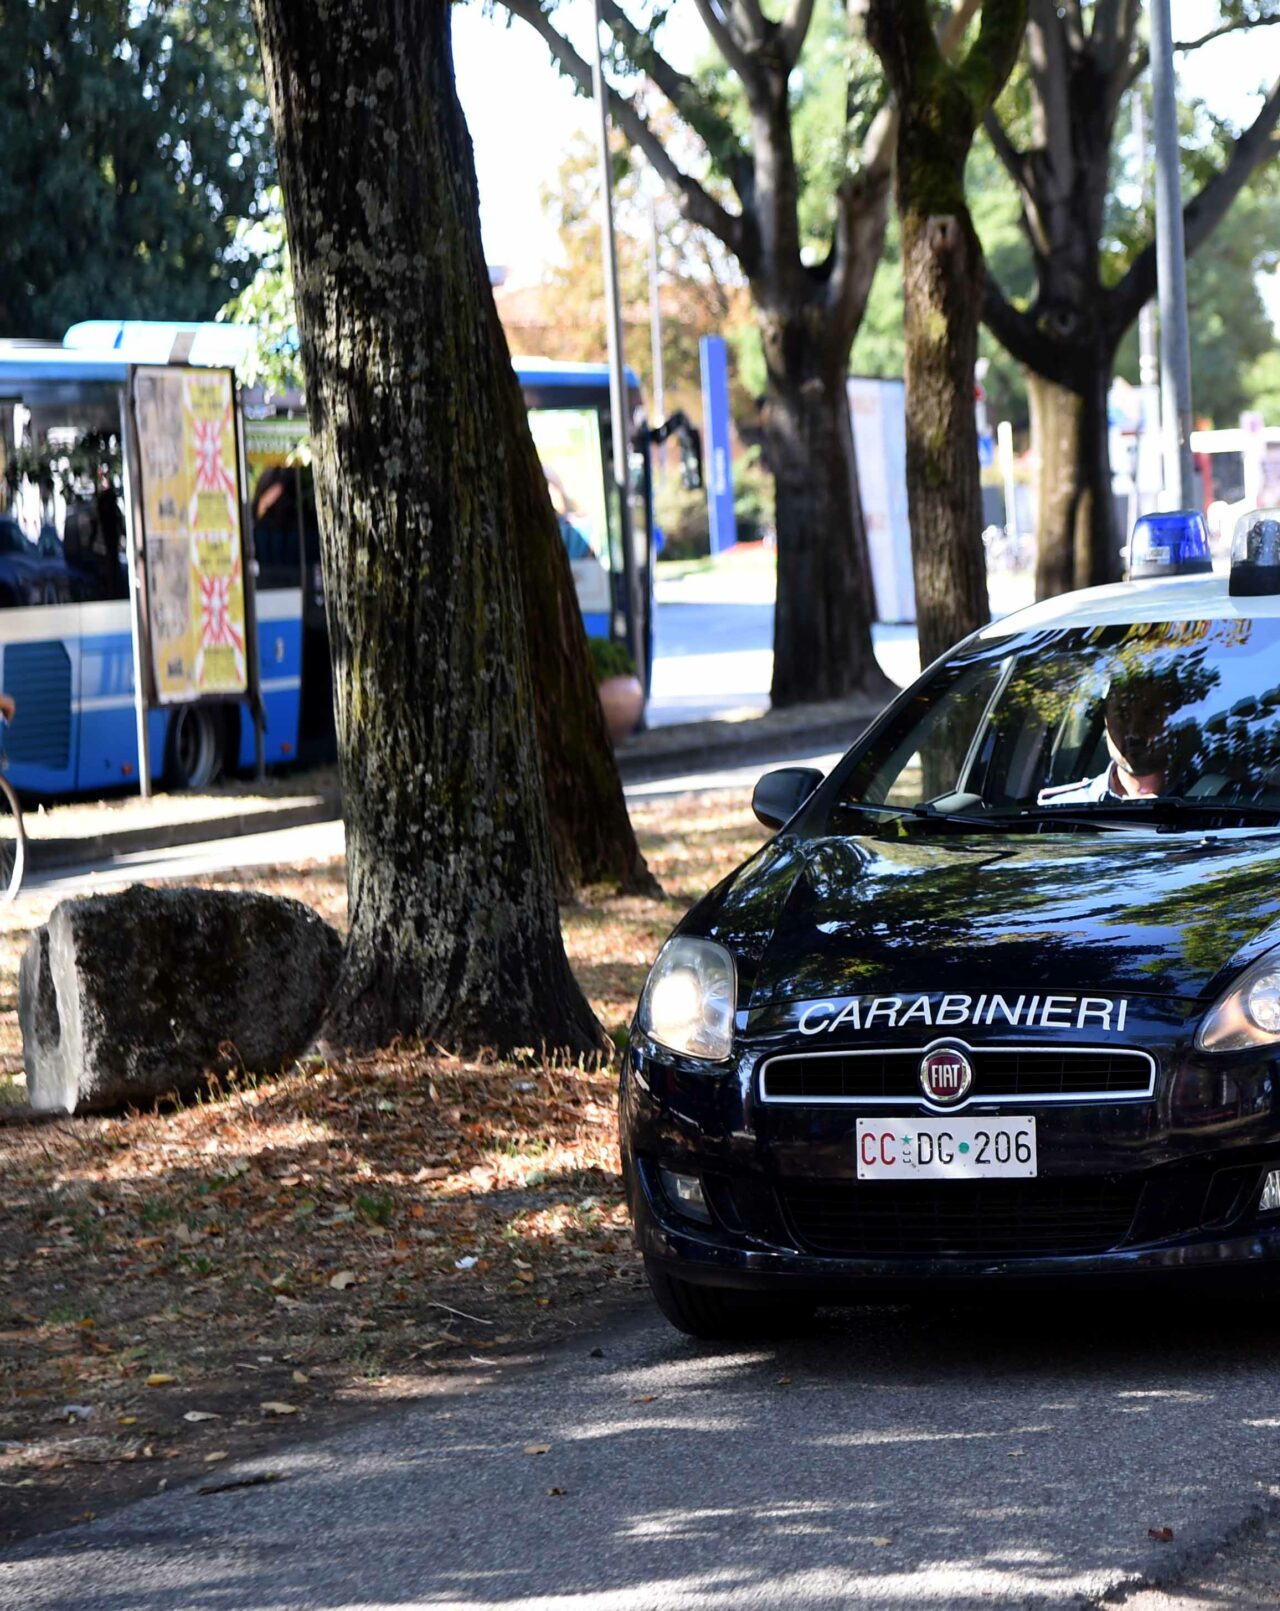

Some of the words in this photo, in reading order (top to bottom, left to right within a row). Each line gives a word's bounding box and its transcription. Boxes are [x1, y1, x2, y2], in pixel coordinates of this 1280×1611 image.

[798, 994, 1128, 1036] CARABINIERI
[931, 1064, 960, 1088] FIAT
[861, 1132, 896, 1165] CC
[917, 1132, 954, 1165] DG
[974, 1131, 1031, 1165] 206
